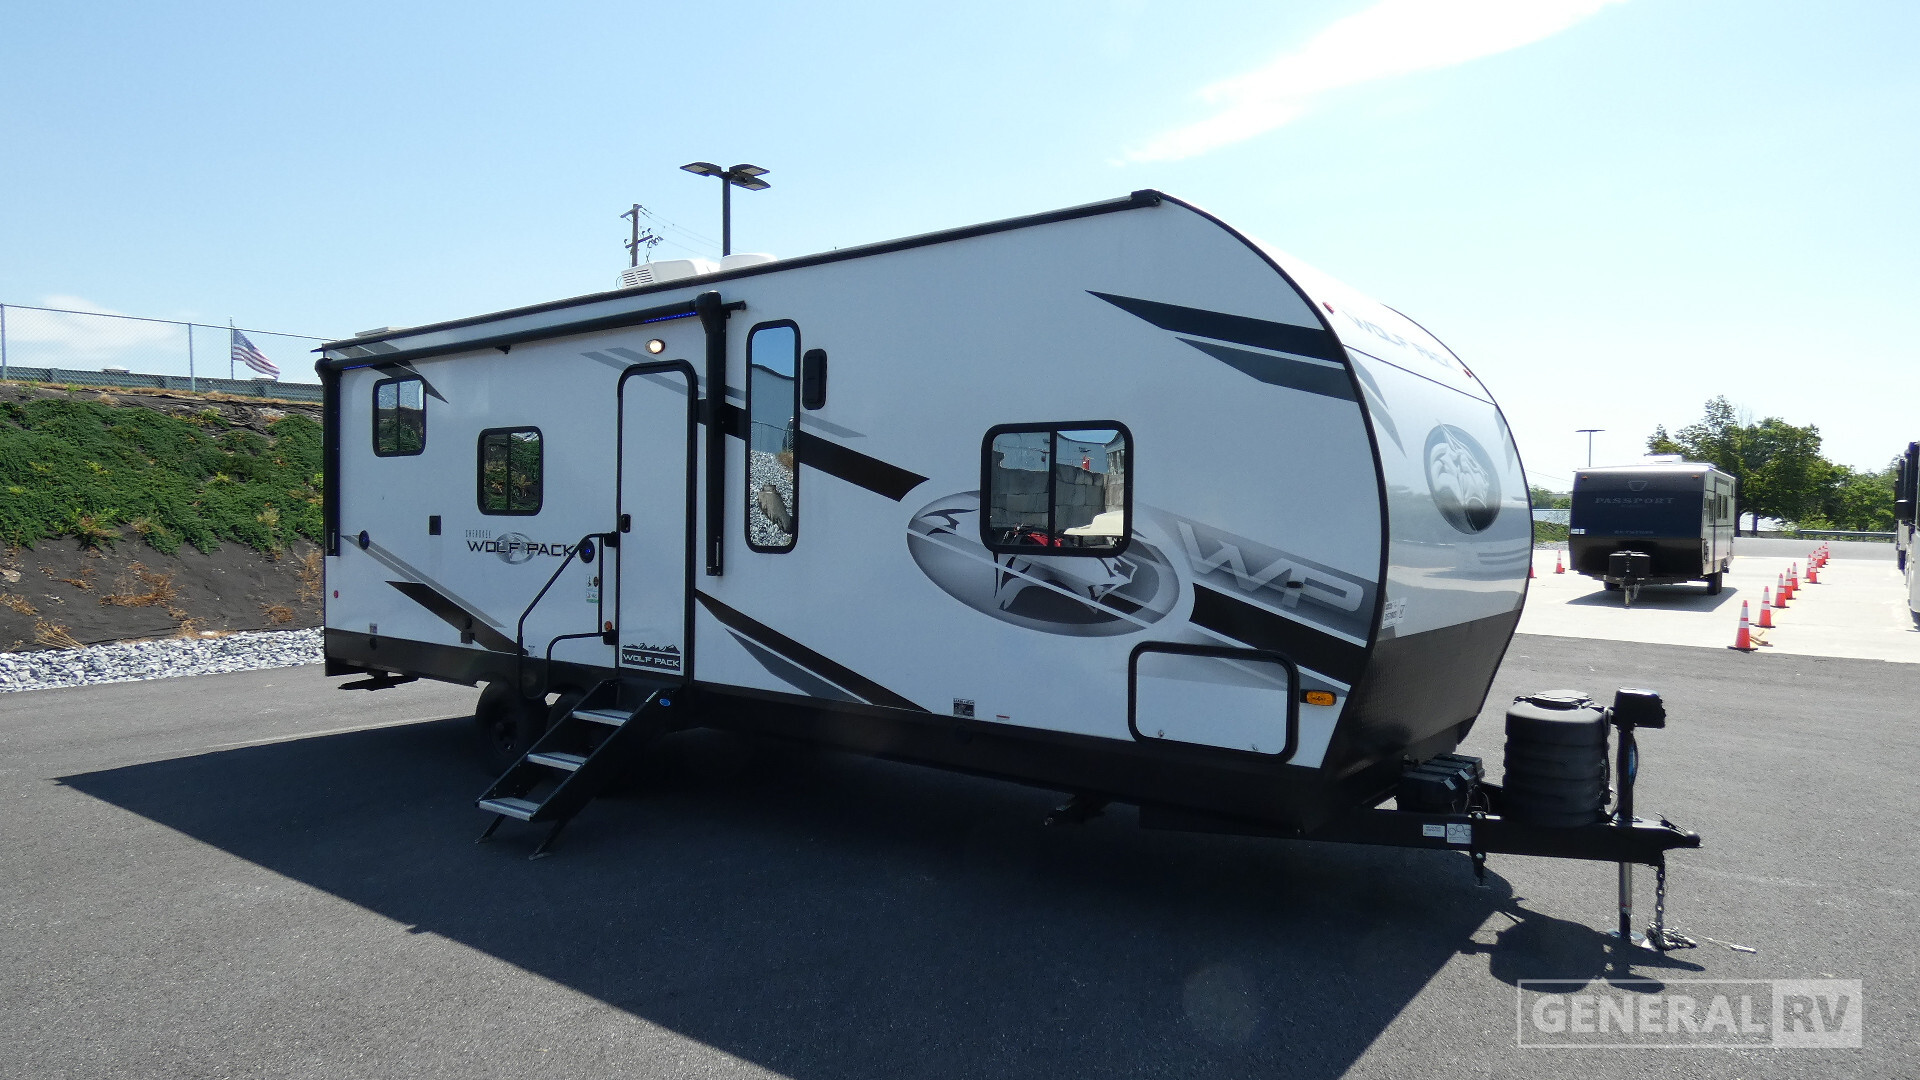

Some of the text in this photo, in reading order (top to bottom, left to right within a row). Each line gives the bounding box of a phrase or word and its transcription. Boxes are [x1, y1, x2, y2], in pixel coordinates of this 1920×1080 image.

[467, 540, 577, 557] WOLF PACK
[622, 653, 680, 667] WOLF PACK
